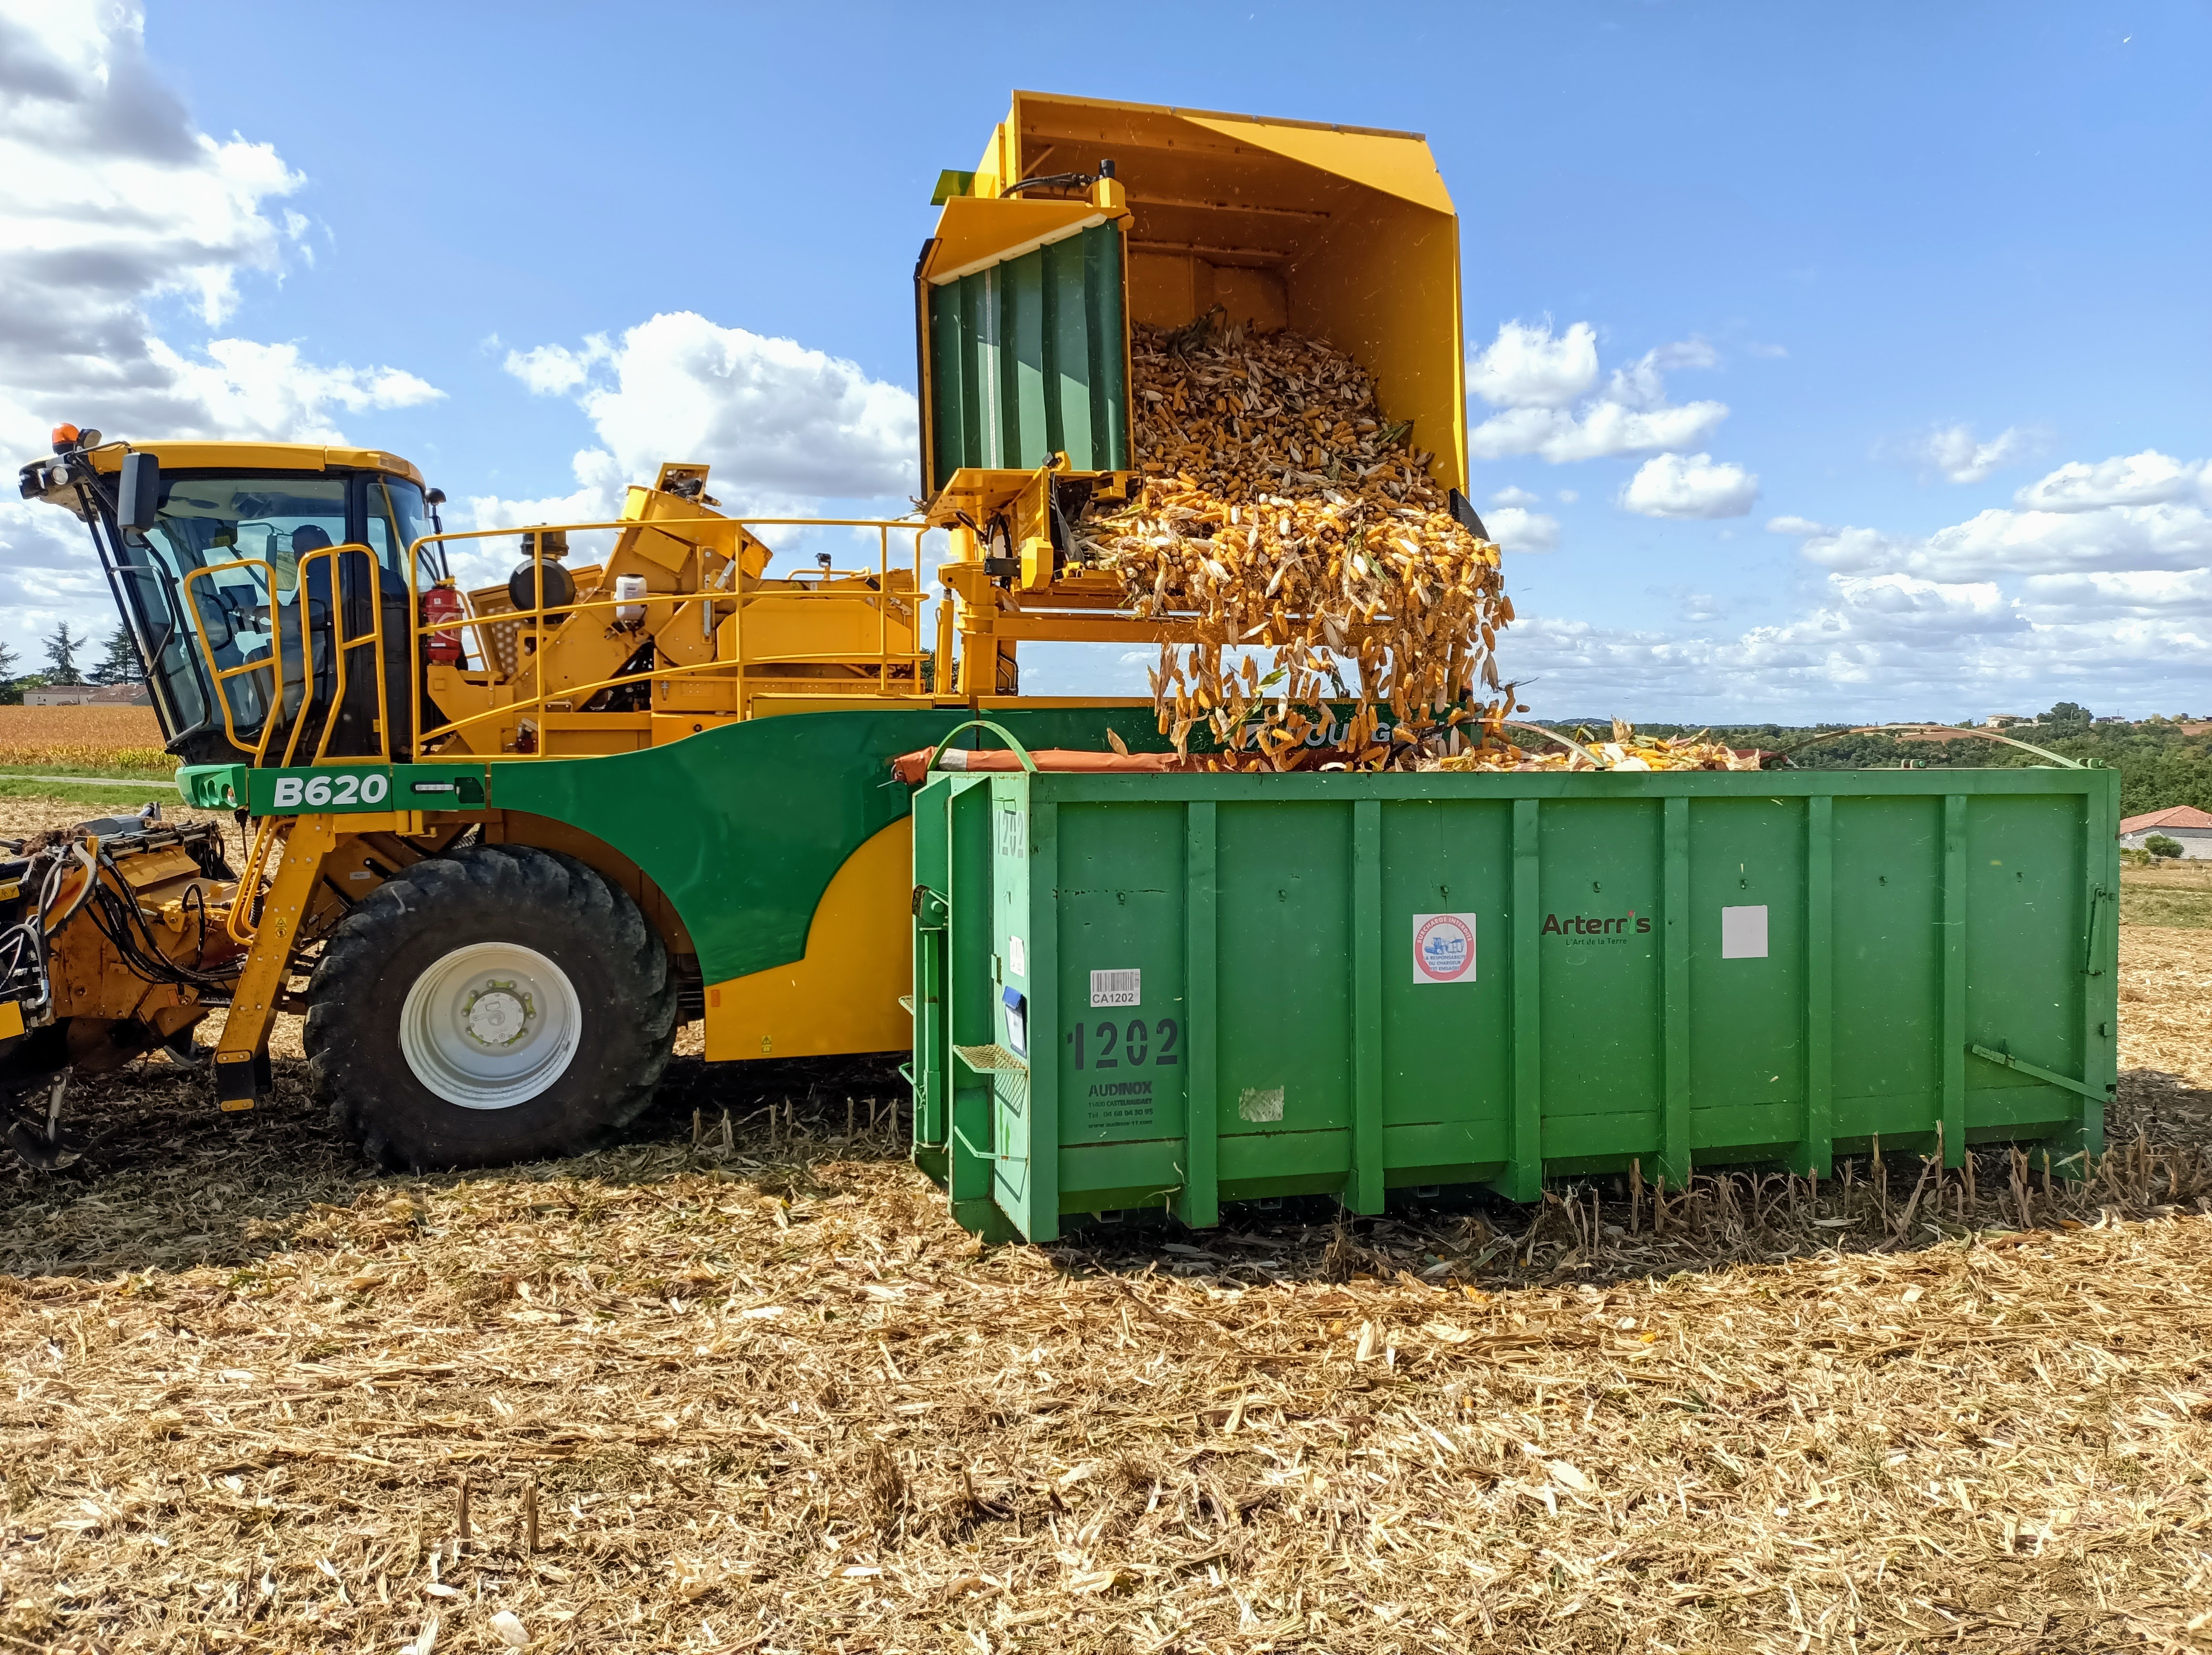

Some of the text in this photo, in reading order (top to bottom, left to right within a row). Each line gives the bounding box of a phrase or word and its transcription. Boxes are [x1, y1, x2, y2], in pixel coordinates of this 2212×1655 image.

[274, 774, 388, 807] B620
[996, 810, 1024, 858] 1202
[1417, 917, 1472, 943] SURCHARGE INTERDITE
[1541, 910, 1651, 935] Arterris
[1093, 993, 1134, 1003] CA1202
[1067, 1018, 1178, 1070] 1202
[1088, 1081, 1152, 1097] AUDINOX
